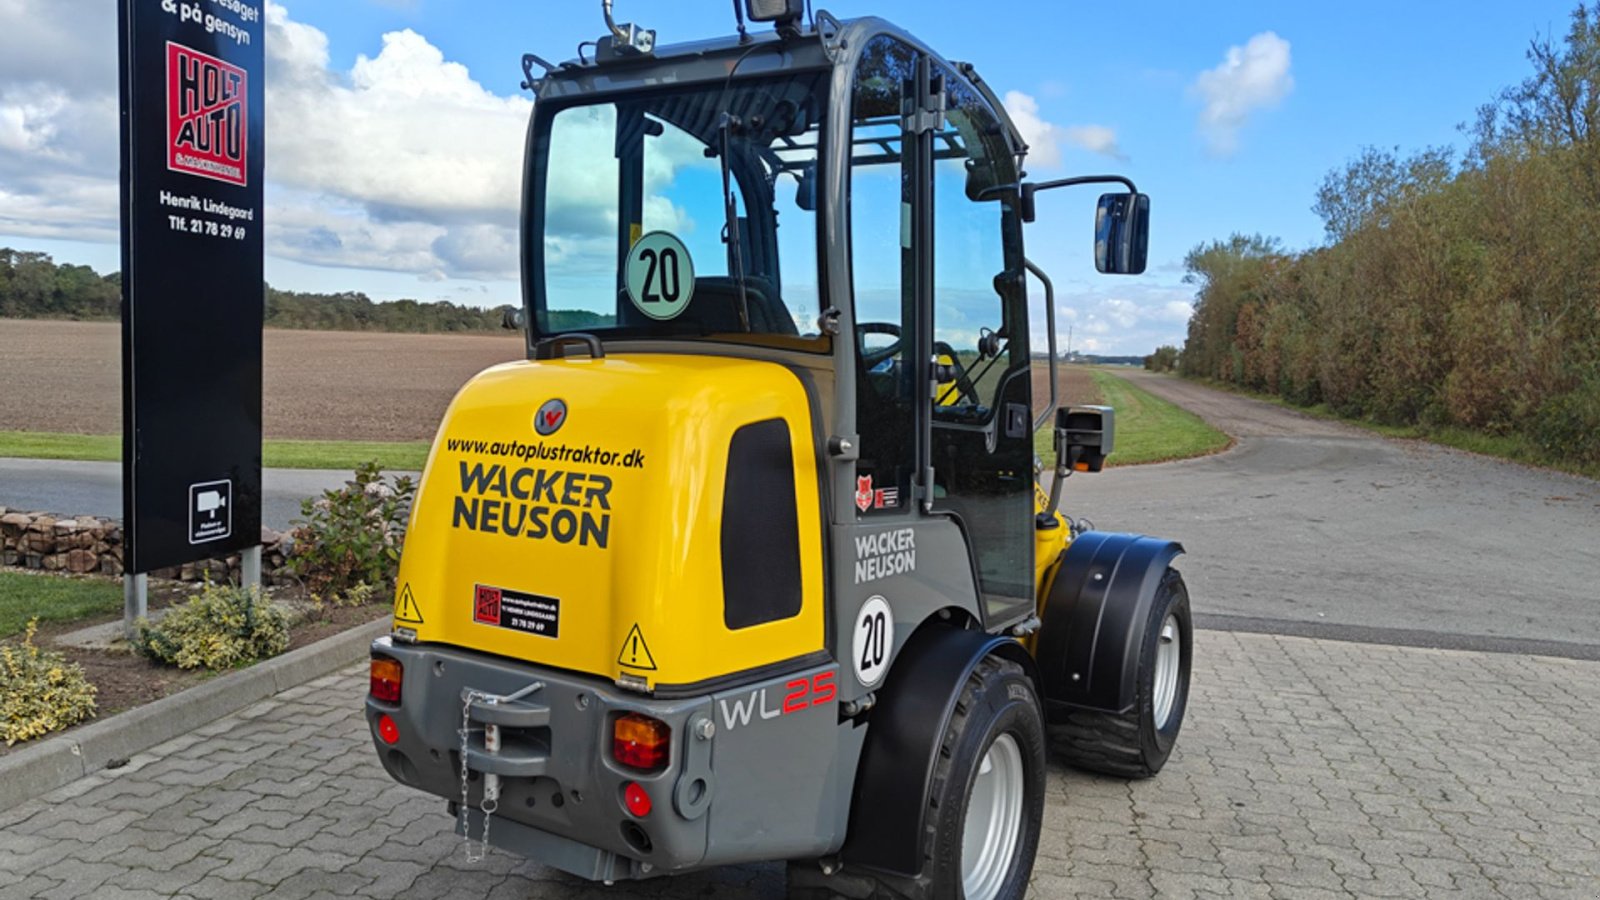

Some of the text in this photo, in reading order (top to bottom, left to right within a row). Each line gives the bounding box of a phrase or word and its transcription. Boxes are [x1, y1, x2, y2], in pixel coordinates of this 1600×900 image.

[161, 0, 250, 45] & på gensyn
[211, 0, 259, 23] esøget
[178, 53, 241, 118] HOLT
[175, 101, 241, 161] AUTO
[160, 190, 253, 220] Henrik Lindegaard
[168, 215, 246, 240] Tlf. 21 78 29 69
[639, 247, 680, 303] 20
[447, 439, 645, 468] www.autoplustraktor.dk
[459, 460, 613, 510] WACKER
[452, 496, 611, 549] NEUSON
[855, 528, 915, 559] WACKER
[855, 550, 916, 584] NEUSON
[511, 618, 518, 626] 21
[519, 619, 526, 628] 78
[860, 611, 885, 671] 20
[720, 671, 836, 730] WL25
